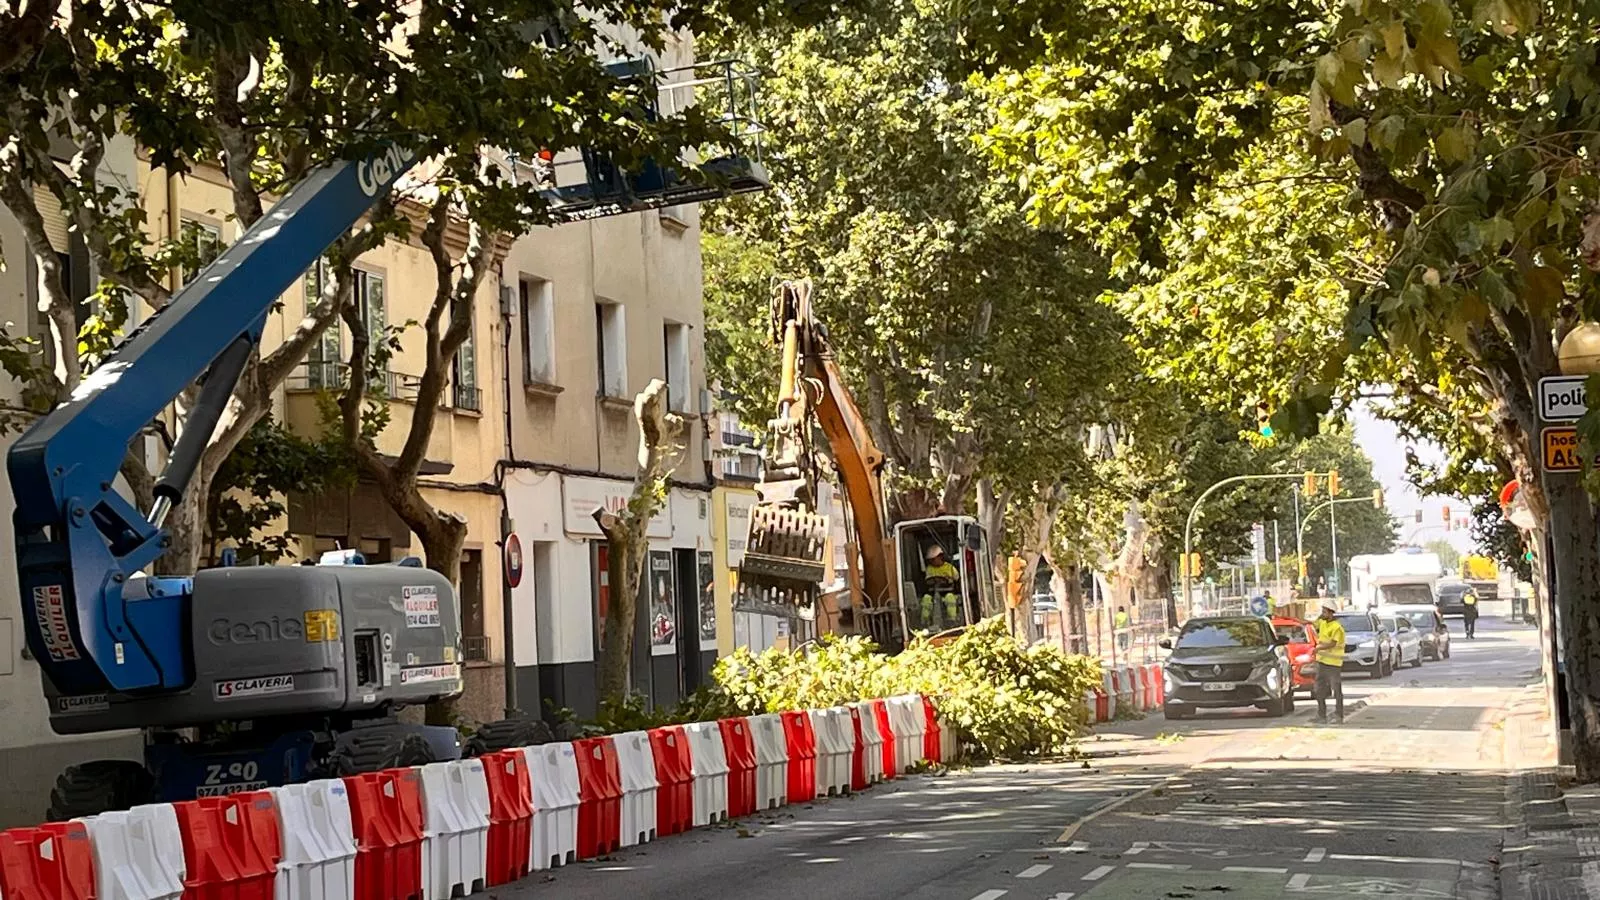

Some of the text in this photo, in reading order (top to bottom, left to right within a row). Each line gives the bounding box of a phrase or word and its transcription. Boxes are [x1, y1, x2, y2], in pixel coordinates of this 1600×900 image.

[35, 587, 54, 645] CLAVERIA
[405, 600, 437, 611] ALQUILER
[48, 586, 78, 658] ALQUILER
[208, 615, 302, 647] Genie
[235, 676, 293, 690] CLAVERIA
[205, 761, 258, 785] Z-90
